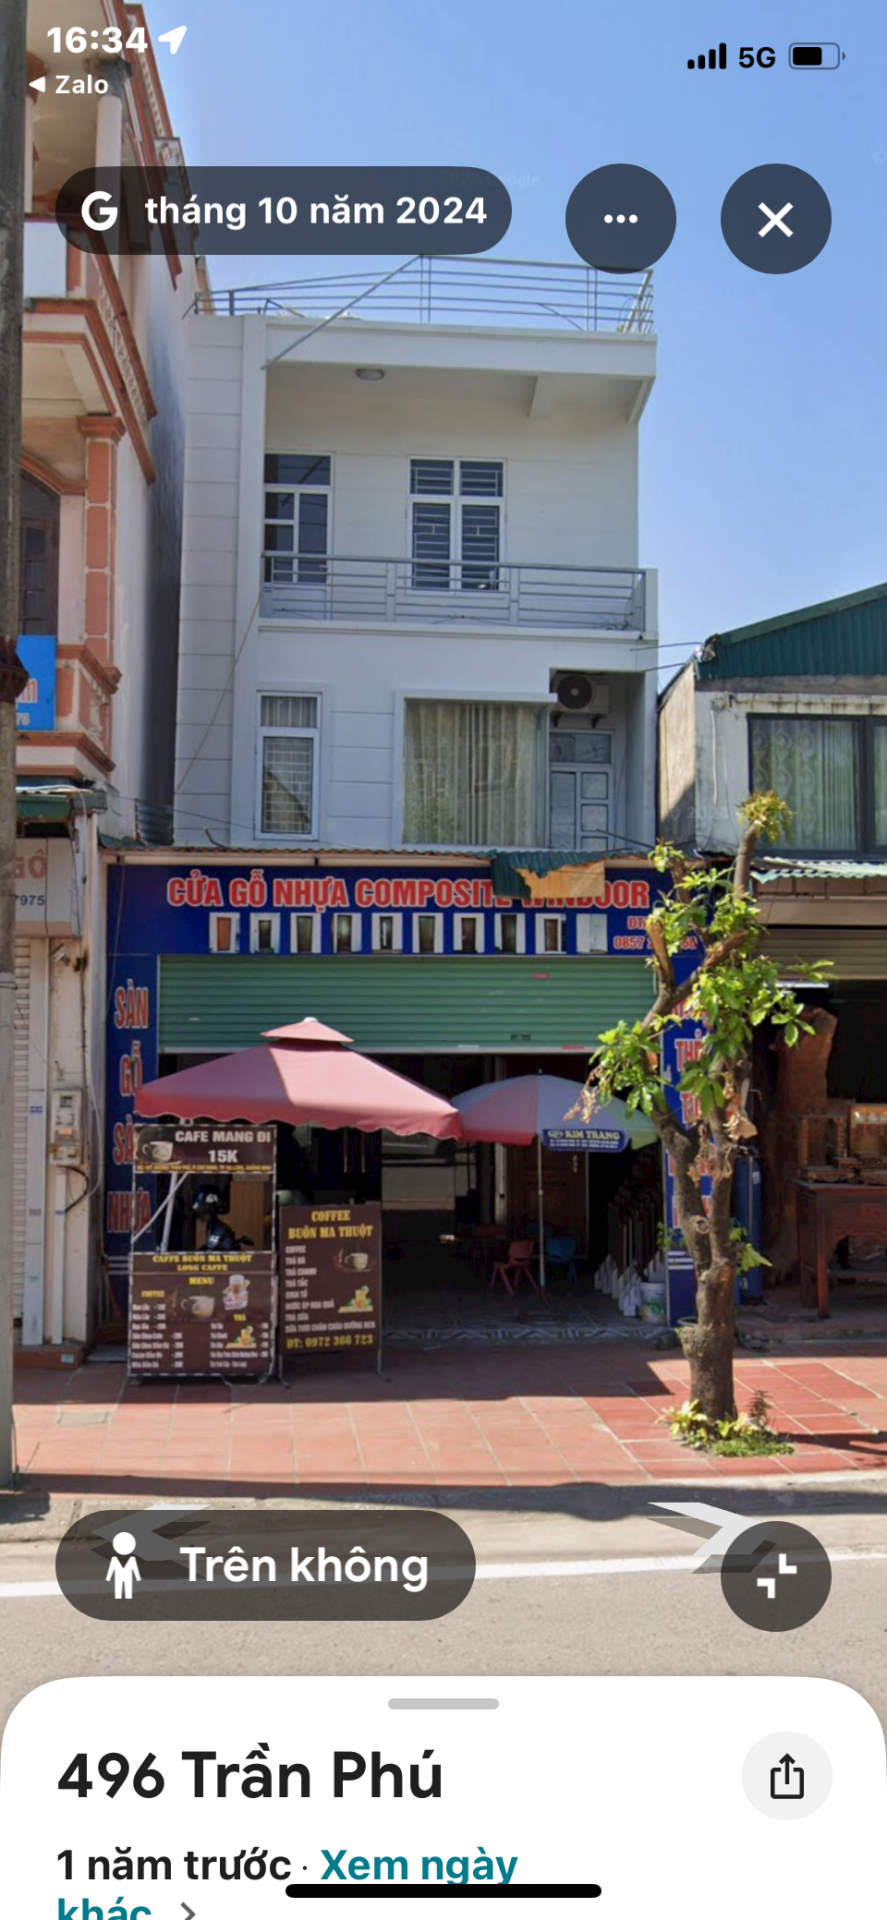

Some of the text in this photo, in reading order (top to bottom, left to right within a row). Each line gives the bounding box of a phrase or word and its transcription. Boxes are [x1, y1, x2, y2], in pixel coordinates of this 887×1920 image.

[167, 869, 224, 907] CỬA
[229, 868, 267, 907] GỖ
[273, 875, 350, 913] NHỰA
[613, 935, 646, 950] 0857
[114, 979, 149, 1029] SÀN
[113, 1114, 135, 1165] SÀ
[174, 1130, 271, 1142] CAFE MANG ĐI
[565, 1130, 620, 1140] KIM TRANG
[207, 1149, 238, 1163] 15K
[311, 1209, 351, 1222] COFFEE
[288, 1223, 373, 1239] BUÔN MA THUỘT
[305, 1335, 330, 1348] 0972
